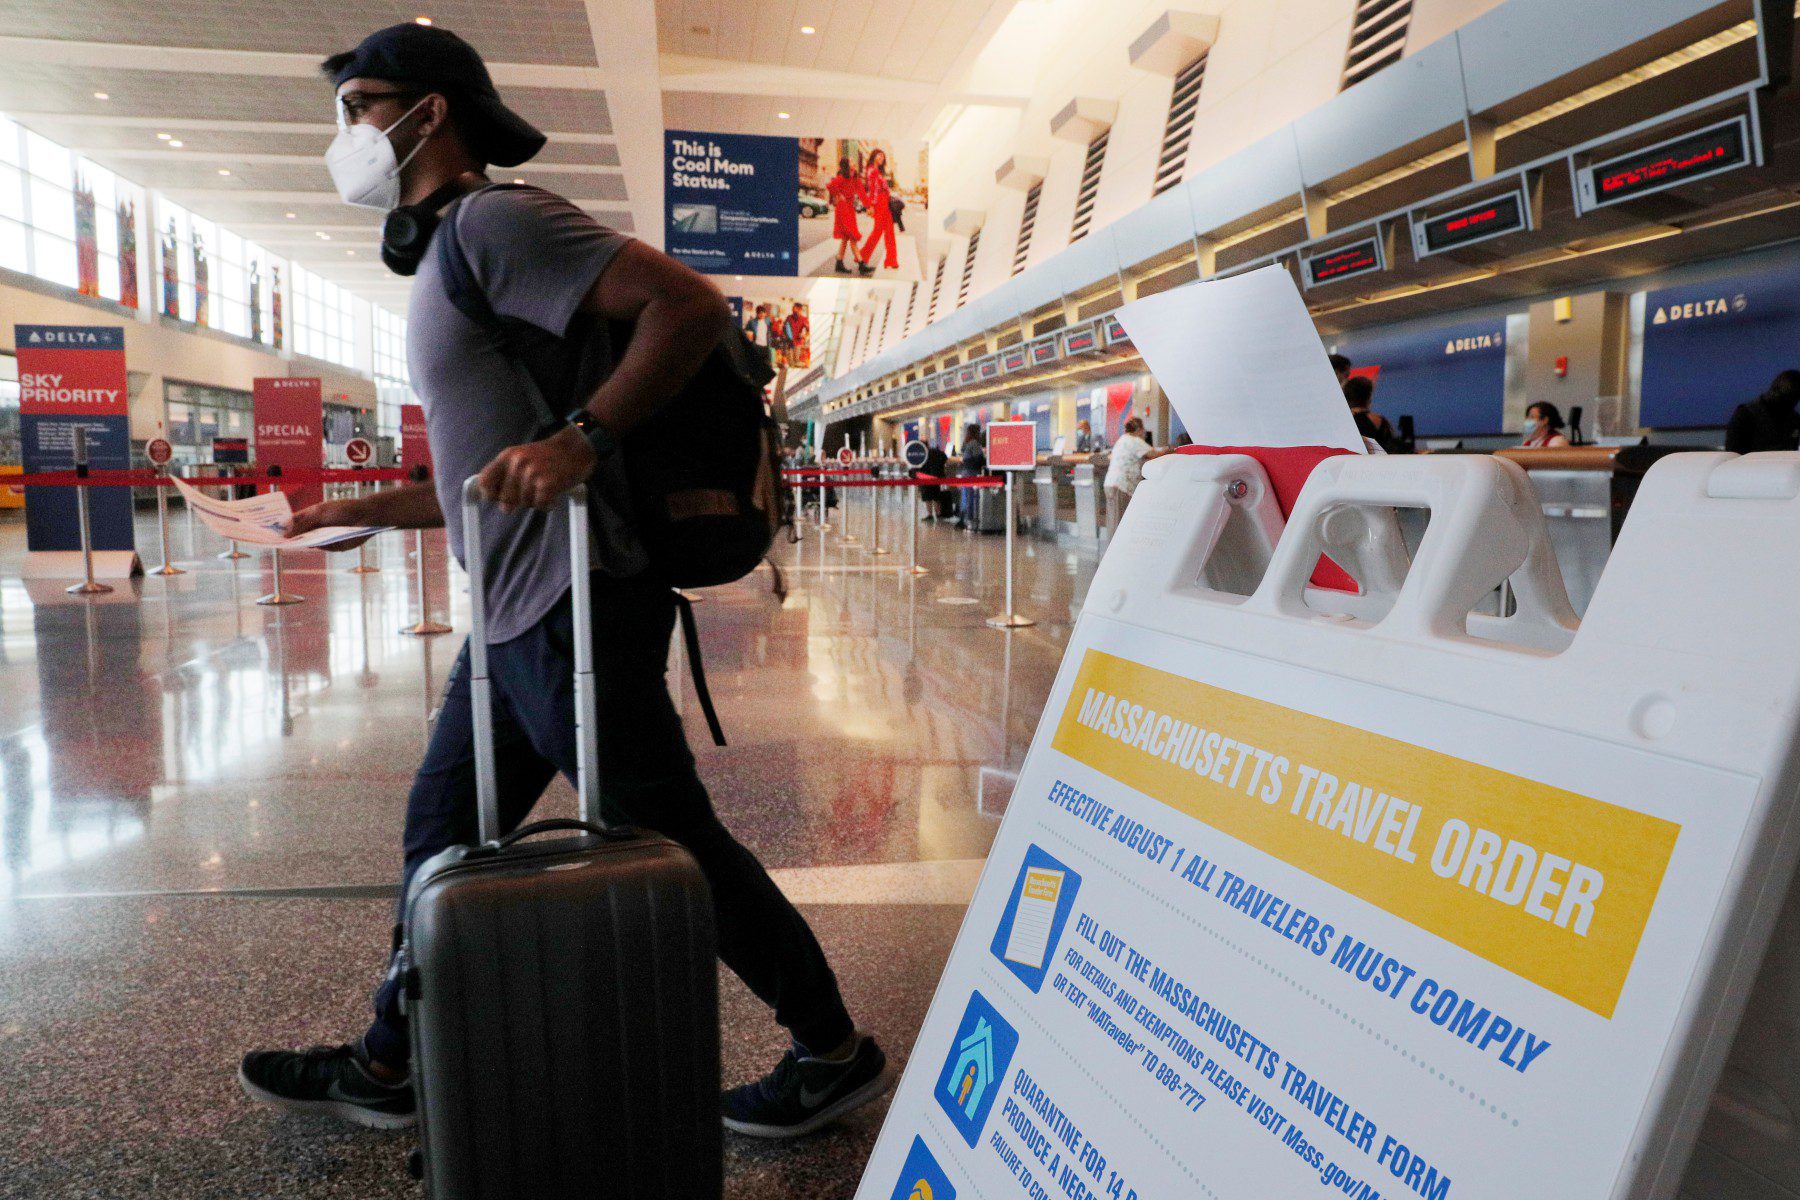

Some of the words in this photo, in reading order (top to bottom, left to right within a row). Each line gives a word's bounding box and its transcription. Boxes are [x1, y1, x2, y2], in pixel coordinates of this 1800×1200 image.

[673, 140, 705, 156] This
[708, 142, 721, 157] is
[672, 156, 710, 172] Cool
[714, 159, 754, 175] Mom
[672, 172, 730, 189] Status.
[1670, 298, 1728, 321] DELTA
[45, 331, 97, 343] DELTA
[1456, 335, 1491, 352] DELTA
[21, 373, 63, 388] SKY
[22, 387, 119, 403] PRIORITY
[258, 424, 312, 437] SPECIAL
[1076, 687, 1290, 805] MASSACHUSETTS
[1289, 764, 1423, 864] TRAVEL
[1430, 817, 1605, 938] ORDER
[1047, 779, 1114, 831] EFFECTIVE
[1107, 814, 1174, 865] AUGUST
[1170, 847, 1186, 873] 1
[1180, 854, 1218, 892] ALL
[1215, 870, 1336, 957] TRAVELERS
[1330, 934, 1417, 1000] MUST
[1410, 978, 1552, 1074] COMPLY
[1052, 972, 1068, 994] OR
[1064, 980, 1089, 1009] TEXT
[1141, 1049, 1159, 1073] TO
[1155, 1062, 1207, 1113] 888-777
[1075, 912, 1099, 946] FILL
[1099, 929, 1127, 964] OUT
[1124, 946, 1152, 984] THE
[1148, 966, 1280, 1080] MASSACHUSETTS
[1280, 1060, 1378, 1155] TRAVELER
[1376, 1134, 1452, 1200] FORM
[1063, 947, 1084, 971] FOR
[1079, 960, 1118, 999] DETAILS
[1113, 988, 1139, 1016] AND
[1134, 1004, 1205, 1070] EXEMPTIONS
[1200, 1058, 1251, 1107] PLEASE
[1246, 1093, 1288, 1136] VISIT
[1281, 1123, 1388, 1200] Mass.gov/M
[1013, 1068, 1083, 1155] QUARANTINE
[1078, 1140, 1107, 1183] FOR
[1105, 1170, 1125, 1200] 14
[989, 1130, 1023, 1176] FAILURE
[1018, 1165, 1033, 1189] TO
[1000, 1096, 1053, 1166] PRODUCE
[1047, 1152, 1061, 1179] A
[1058, 1163, 1098, 1200] NEG
